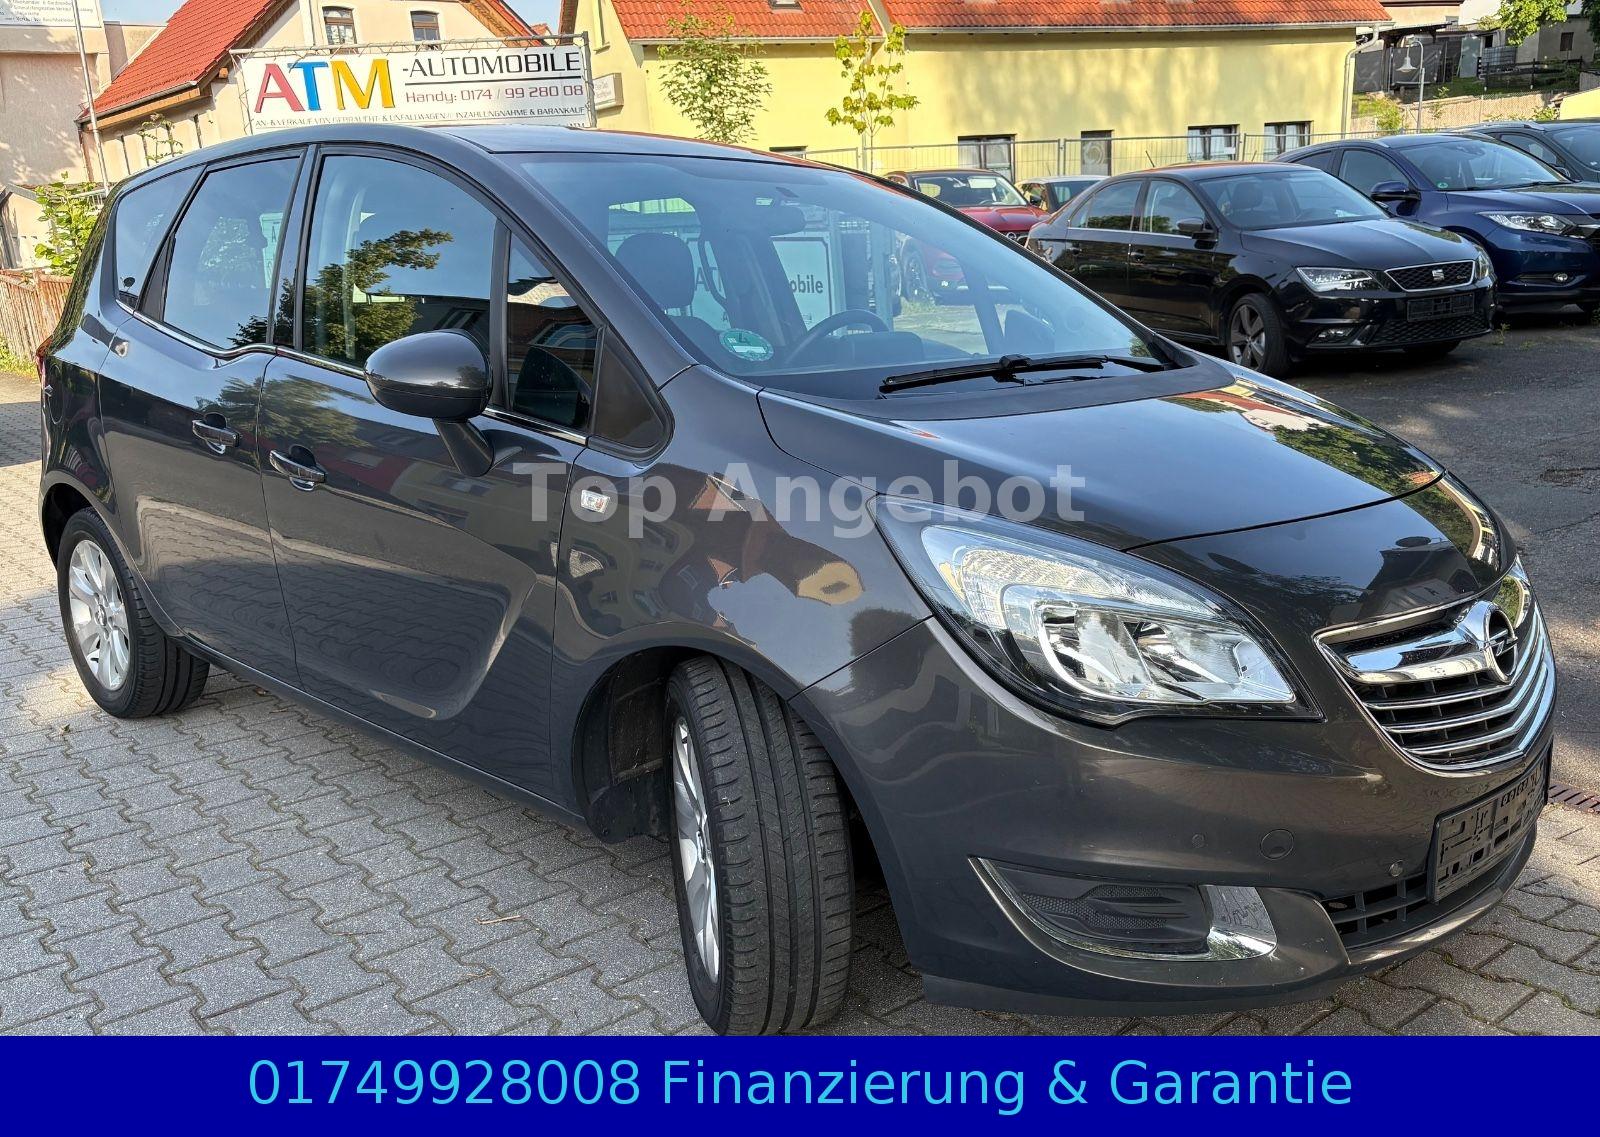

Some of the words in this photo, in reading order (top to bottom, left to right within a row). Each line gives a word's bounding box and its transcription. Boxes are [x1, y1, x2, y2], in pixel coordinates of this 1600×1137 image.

[254, 58, 395, 113] ATM
[406, 90, 458, 105] Handy:
[460, 88, 493, 102] 0174
[504, 87, 525, 99] 99
[528, 85, 559, 98] 280
[562, 84, 584, 97] 08
[529, 108, 536, 116] &
[537, 106, 585, 116] BARANKAUF
